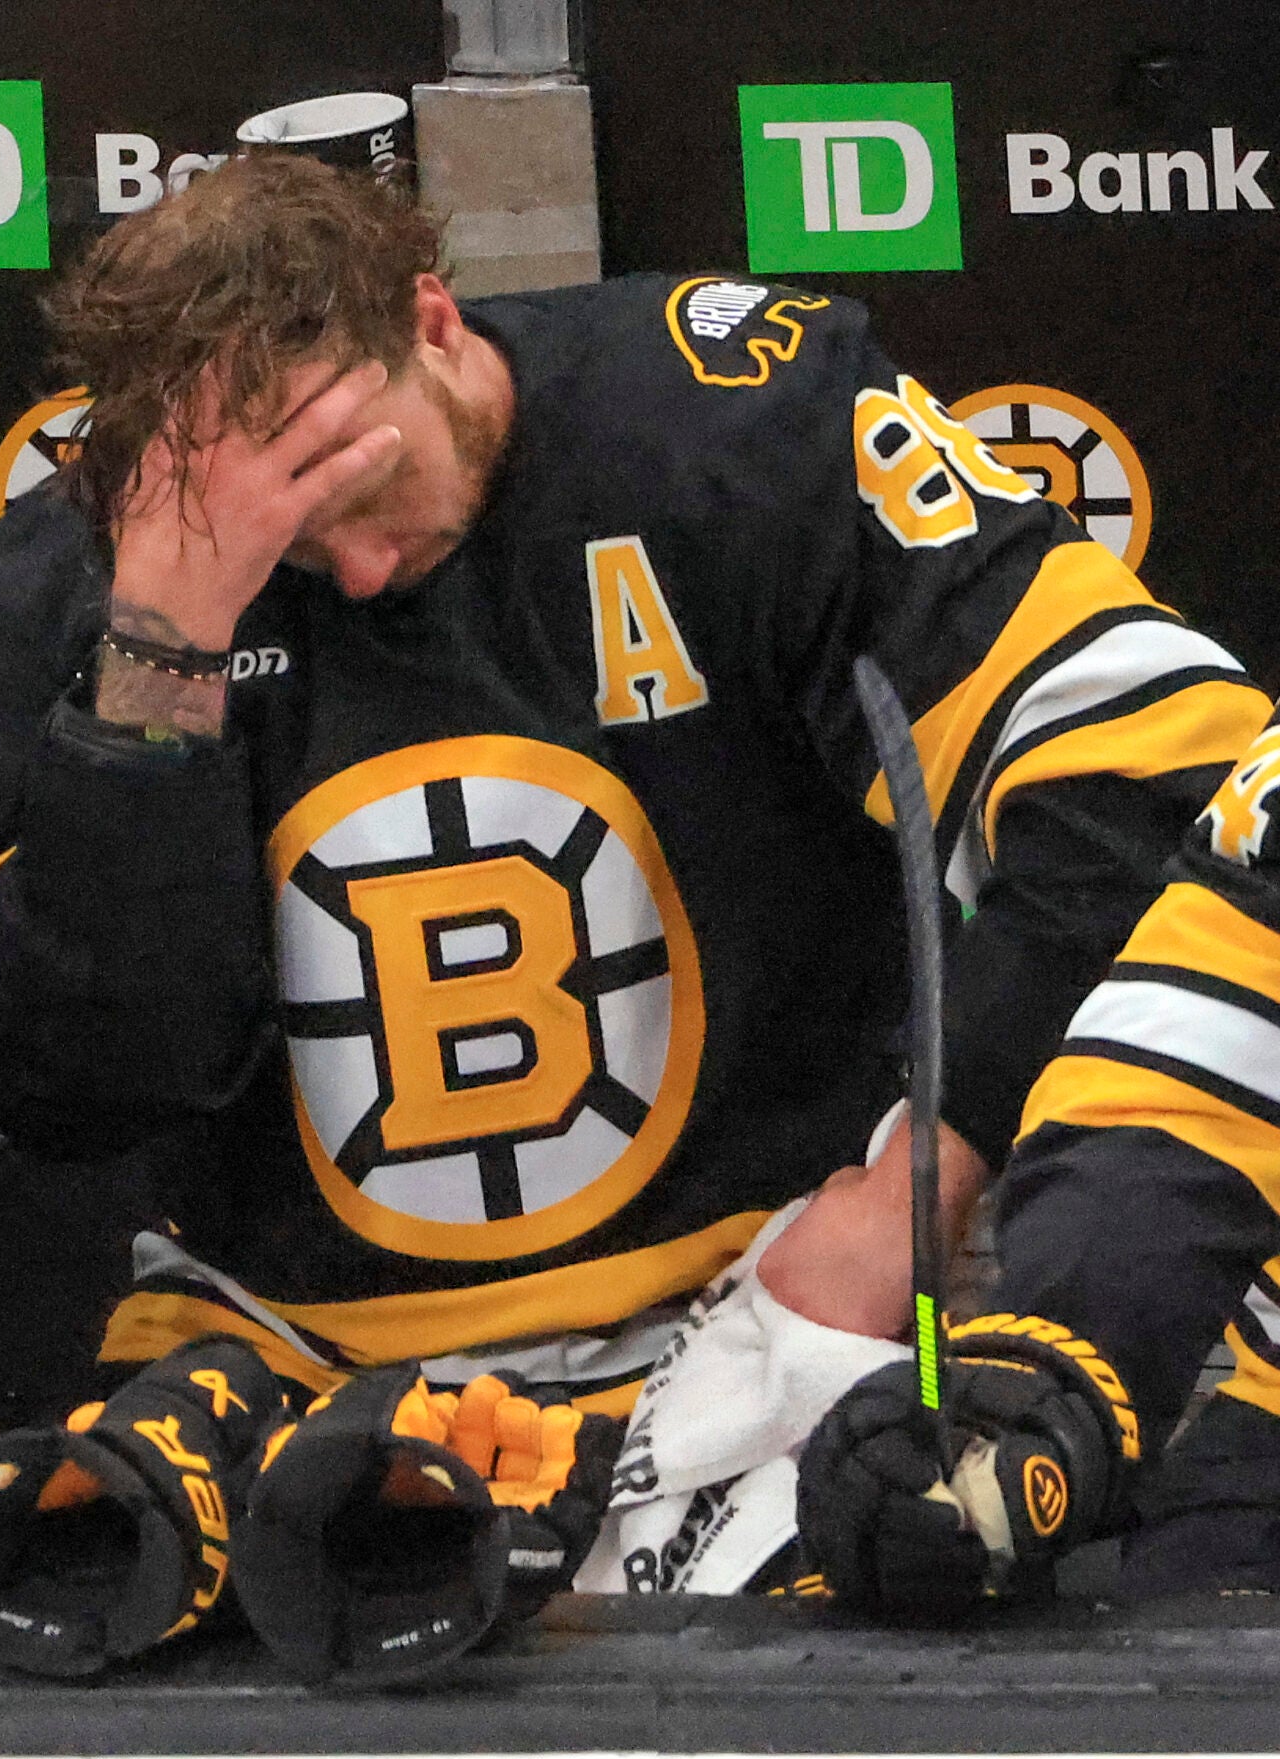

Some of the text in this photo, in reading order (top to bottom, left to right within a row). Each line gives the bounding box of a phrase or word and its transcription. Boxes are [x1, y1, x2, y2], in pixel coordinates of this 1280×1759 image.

[96, 133, 248, 213] Ba
[763, 121, 1274, 233] TD Bank
[687, 282, 768, 340] BRUINS
[587, 535, 709, 726] A
[346, 856, 593, 1150] B
